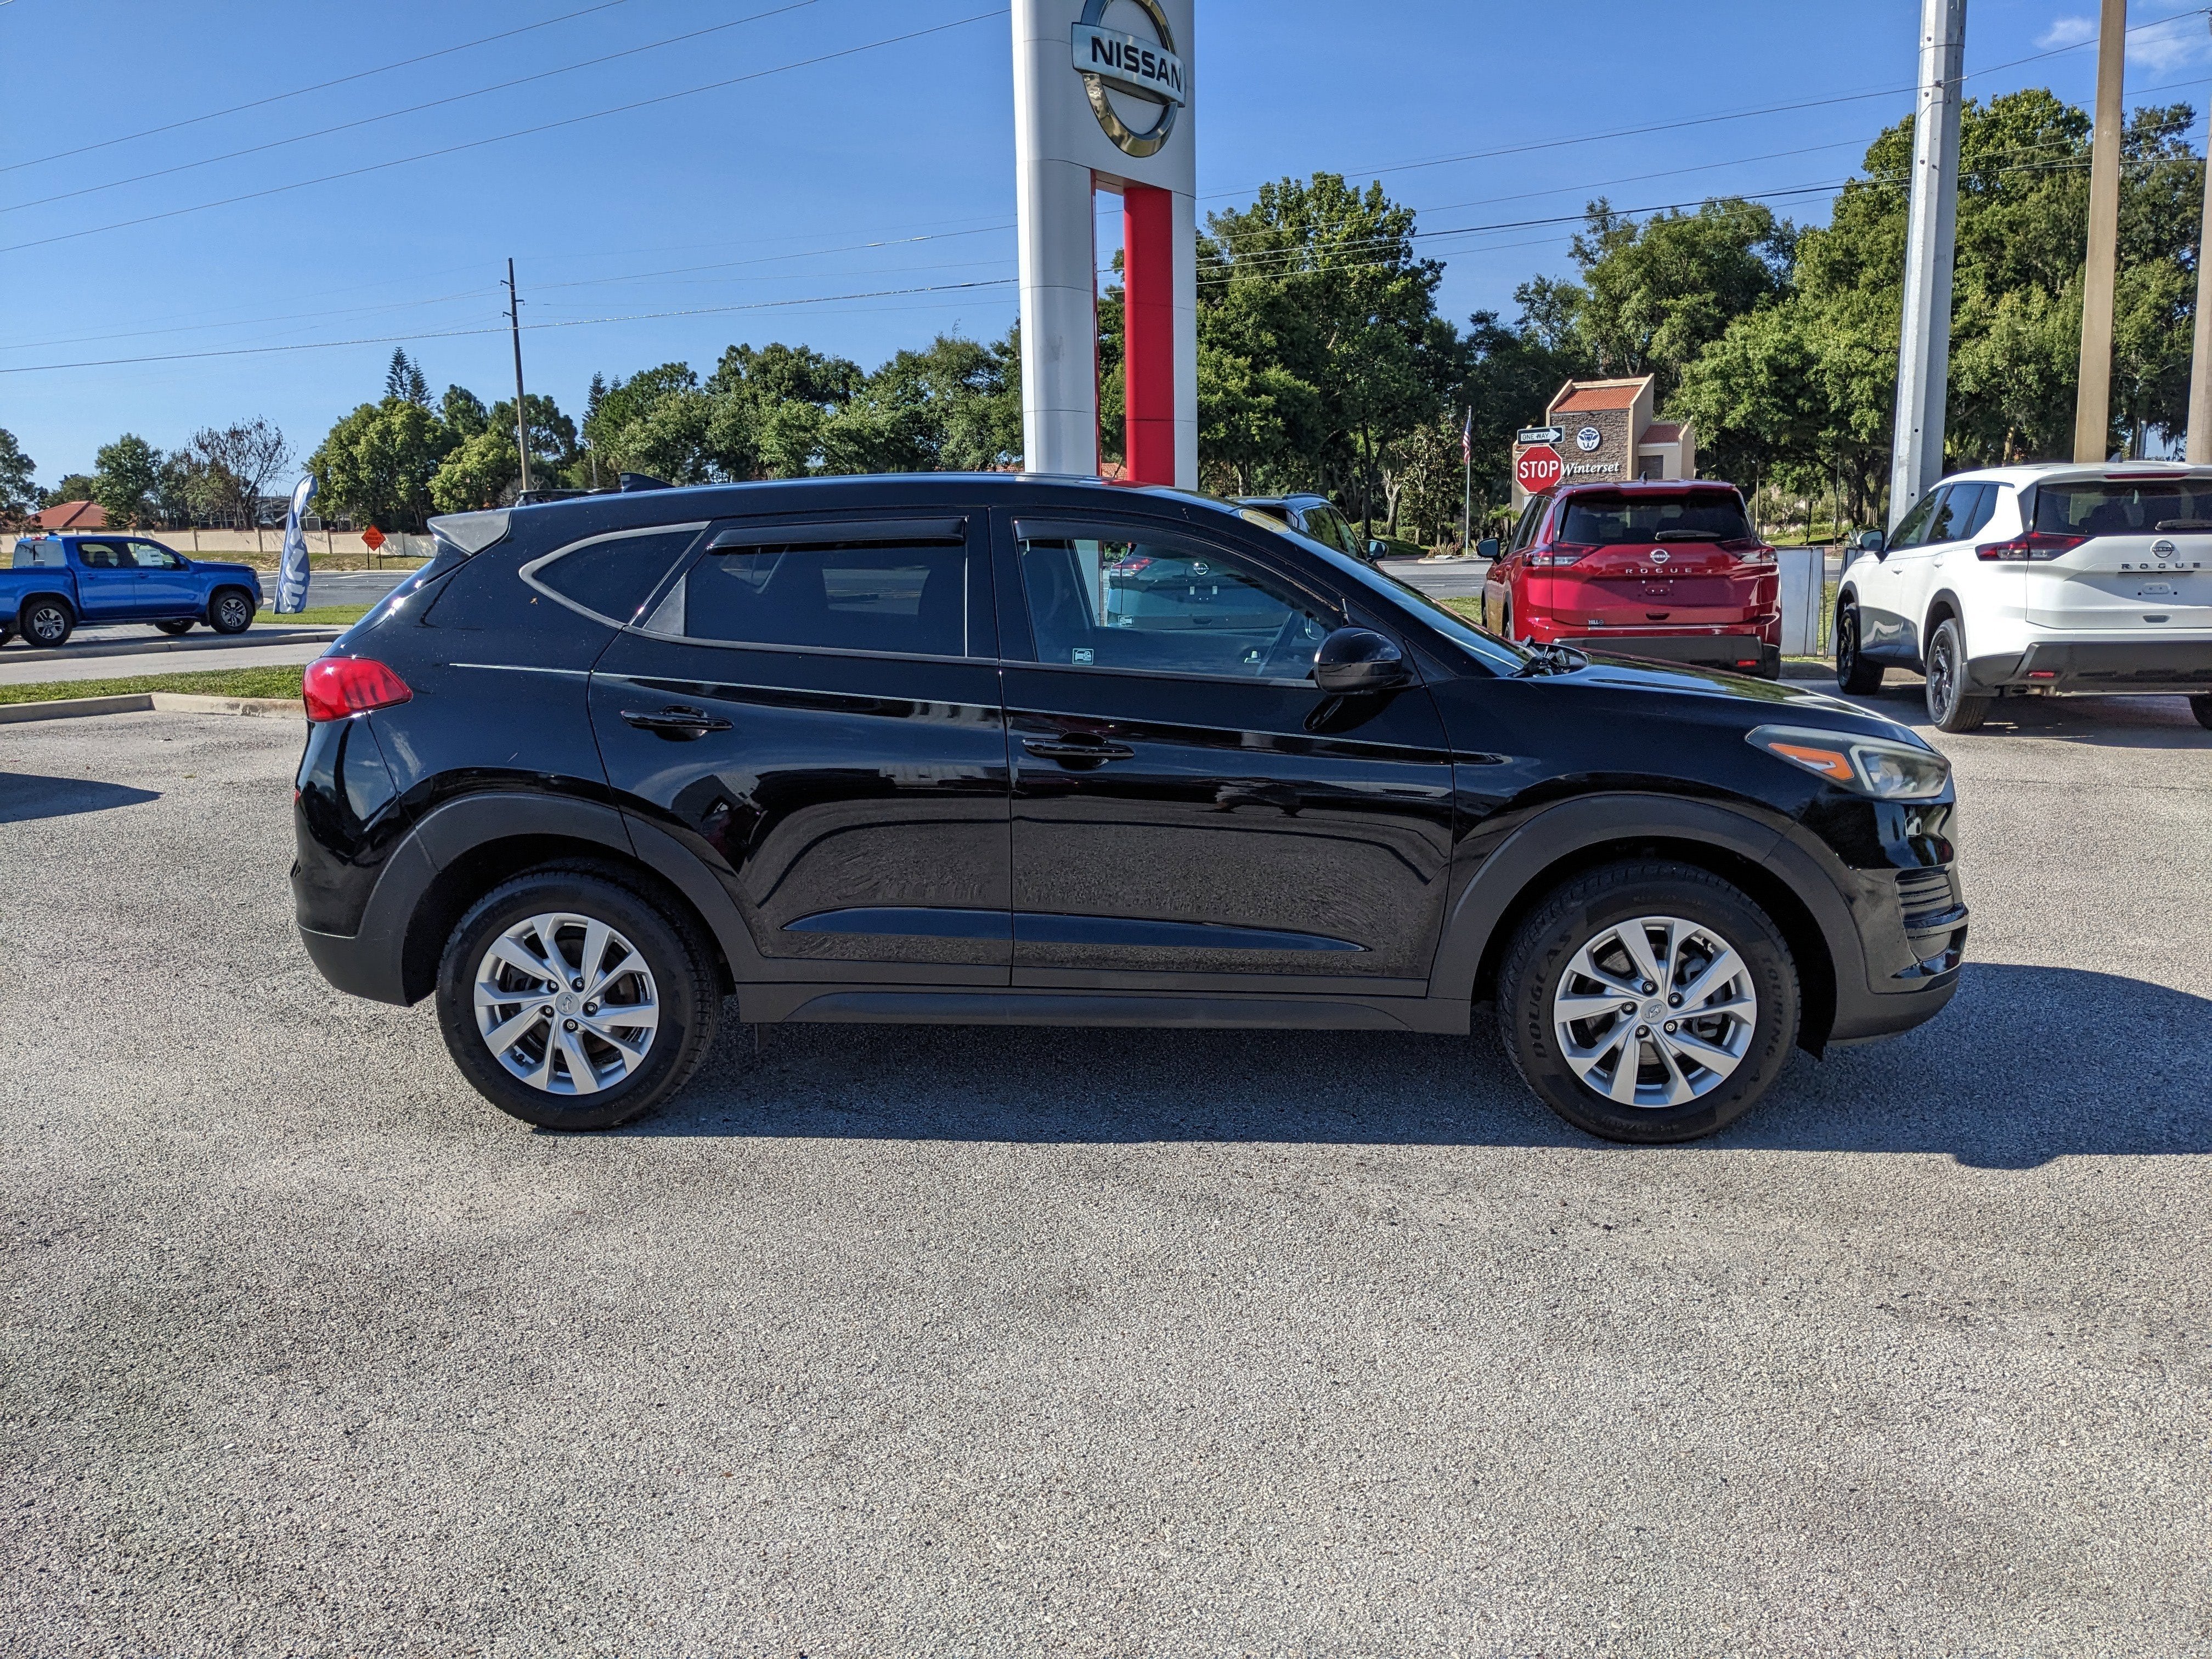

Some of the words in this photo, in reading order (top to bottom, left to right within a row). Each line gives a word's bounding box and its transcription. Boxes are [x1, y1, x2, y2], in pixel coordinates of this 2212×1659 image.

[1091, 36, 1181, 93] NISSAN
[1519, 460, 1559, 479] STOP
[1561, 462, 1620, 476] Winterset
